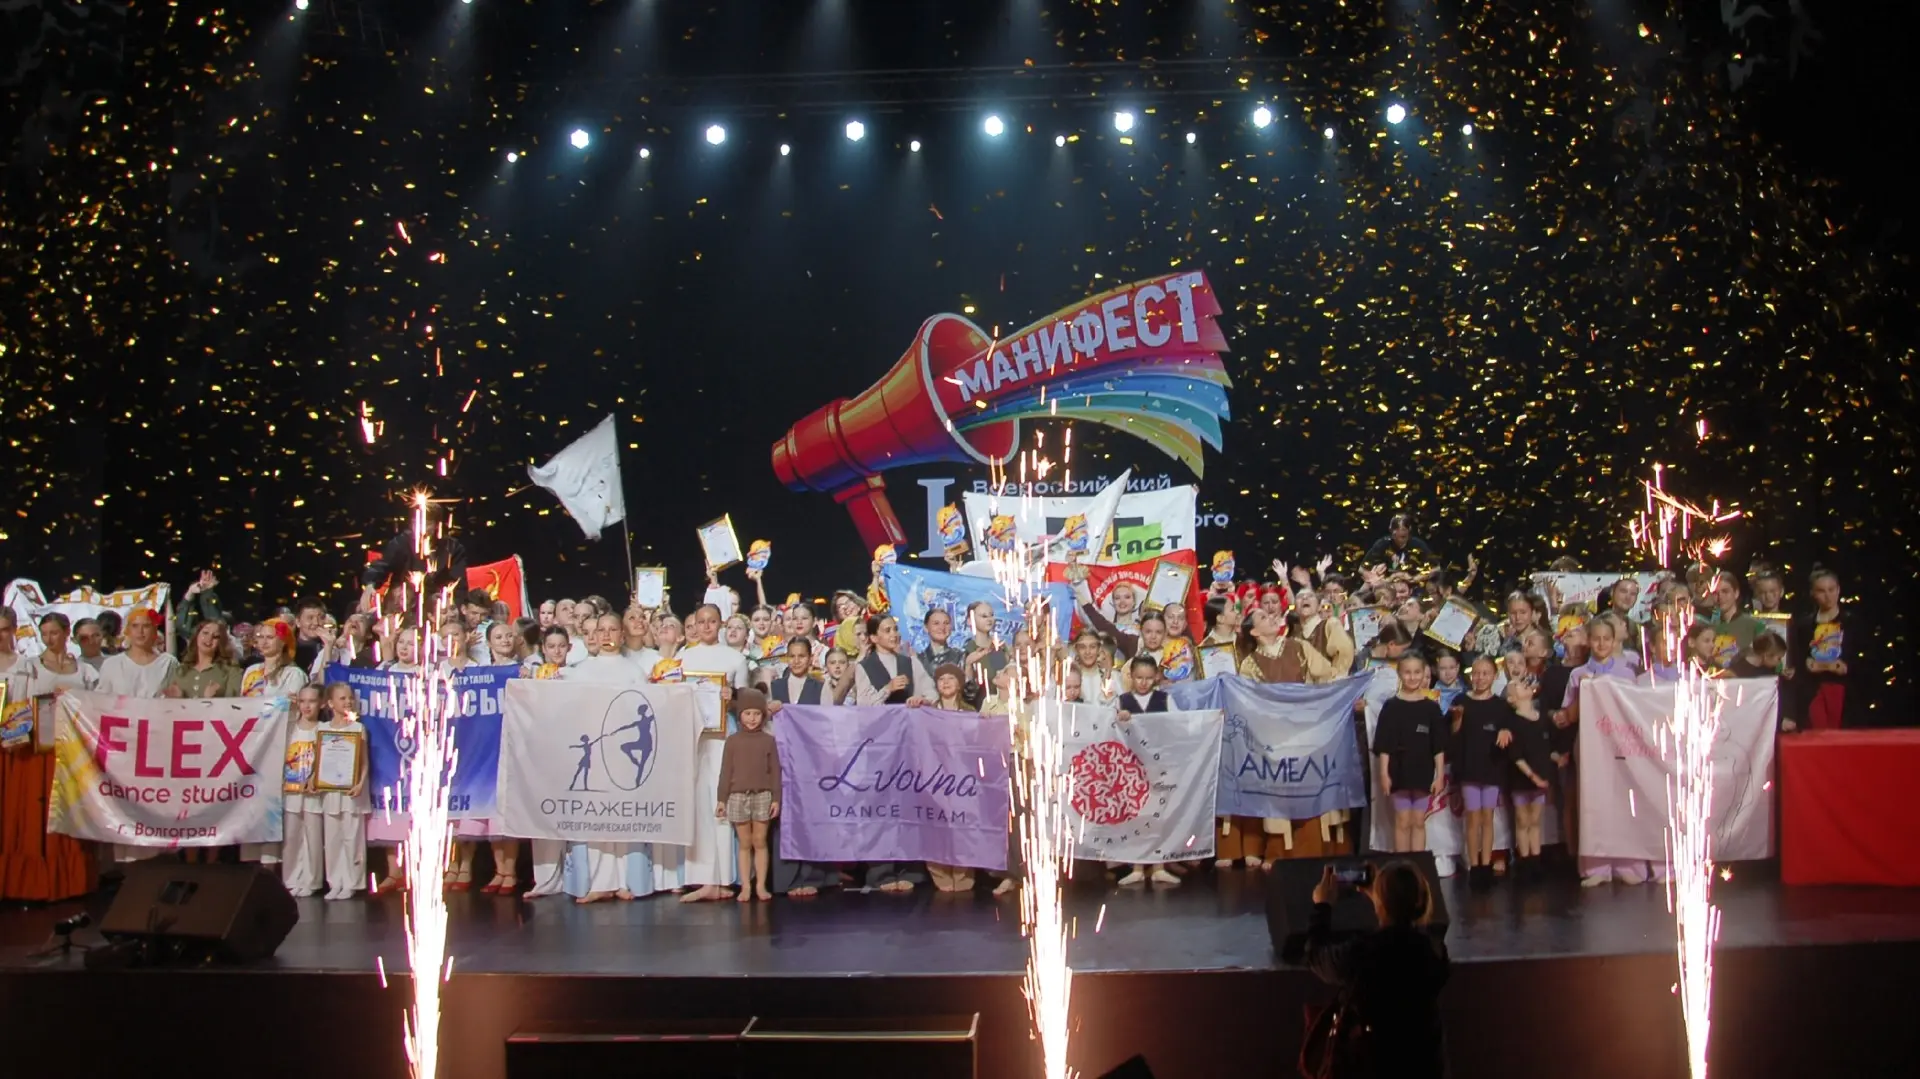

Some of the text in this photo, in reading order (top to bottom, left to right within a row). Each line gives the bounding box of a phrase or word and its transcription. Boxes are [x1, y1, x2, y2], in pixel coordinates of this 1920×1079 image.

[954, 271, 1204, 402] МАНИФЕСТ
[972, 473, 1172, 497] Всероссийкий
[95, 715, 260, 779] FLEX
[817, 737, 978, 797] Lvovna
[98, 779, 255, 805] dance studio
[540, 798, 676, 818] ОТРАЖЕНИЕ
[829, 804, 966, 823] DANCE TEAM
[134, 821, 217, 839] Волгоград
